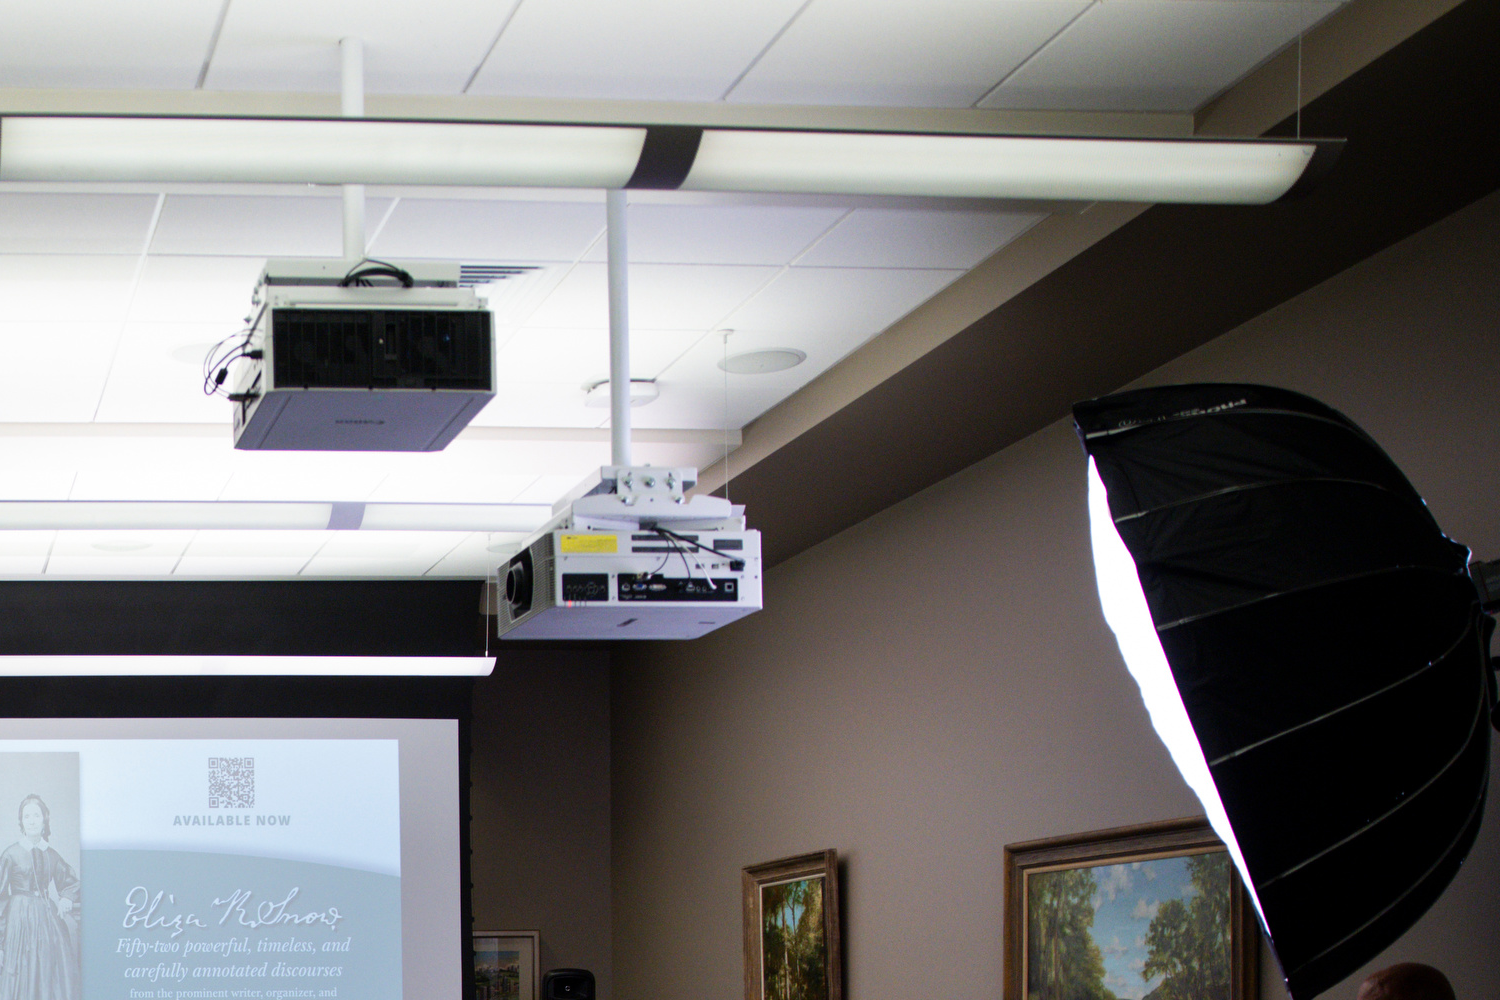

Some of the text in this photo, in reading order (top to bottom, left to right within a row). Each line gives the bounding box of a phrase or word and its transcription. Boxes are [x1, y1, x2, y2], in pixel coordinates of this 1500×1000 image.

[173, 814, 292, 827] AVAILABLE NOW
[122, 886, 206, 938] Eliza
[116, 937, 351, 957] Fifty-two powerful, timeless, and
[124, 962, 343, 982] carefully annotated discourses
[130, 988, 337, 1000] from the prominent writer, organizer, and
